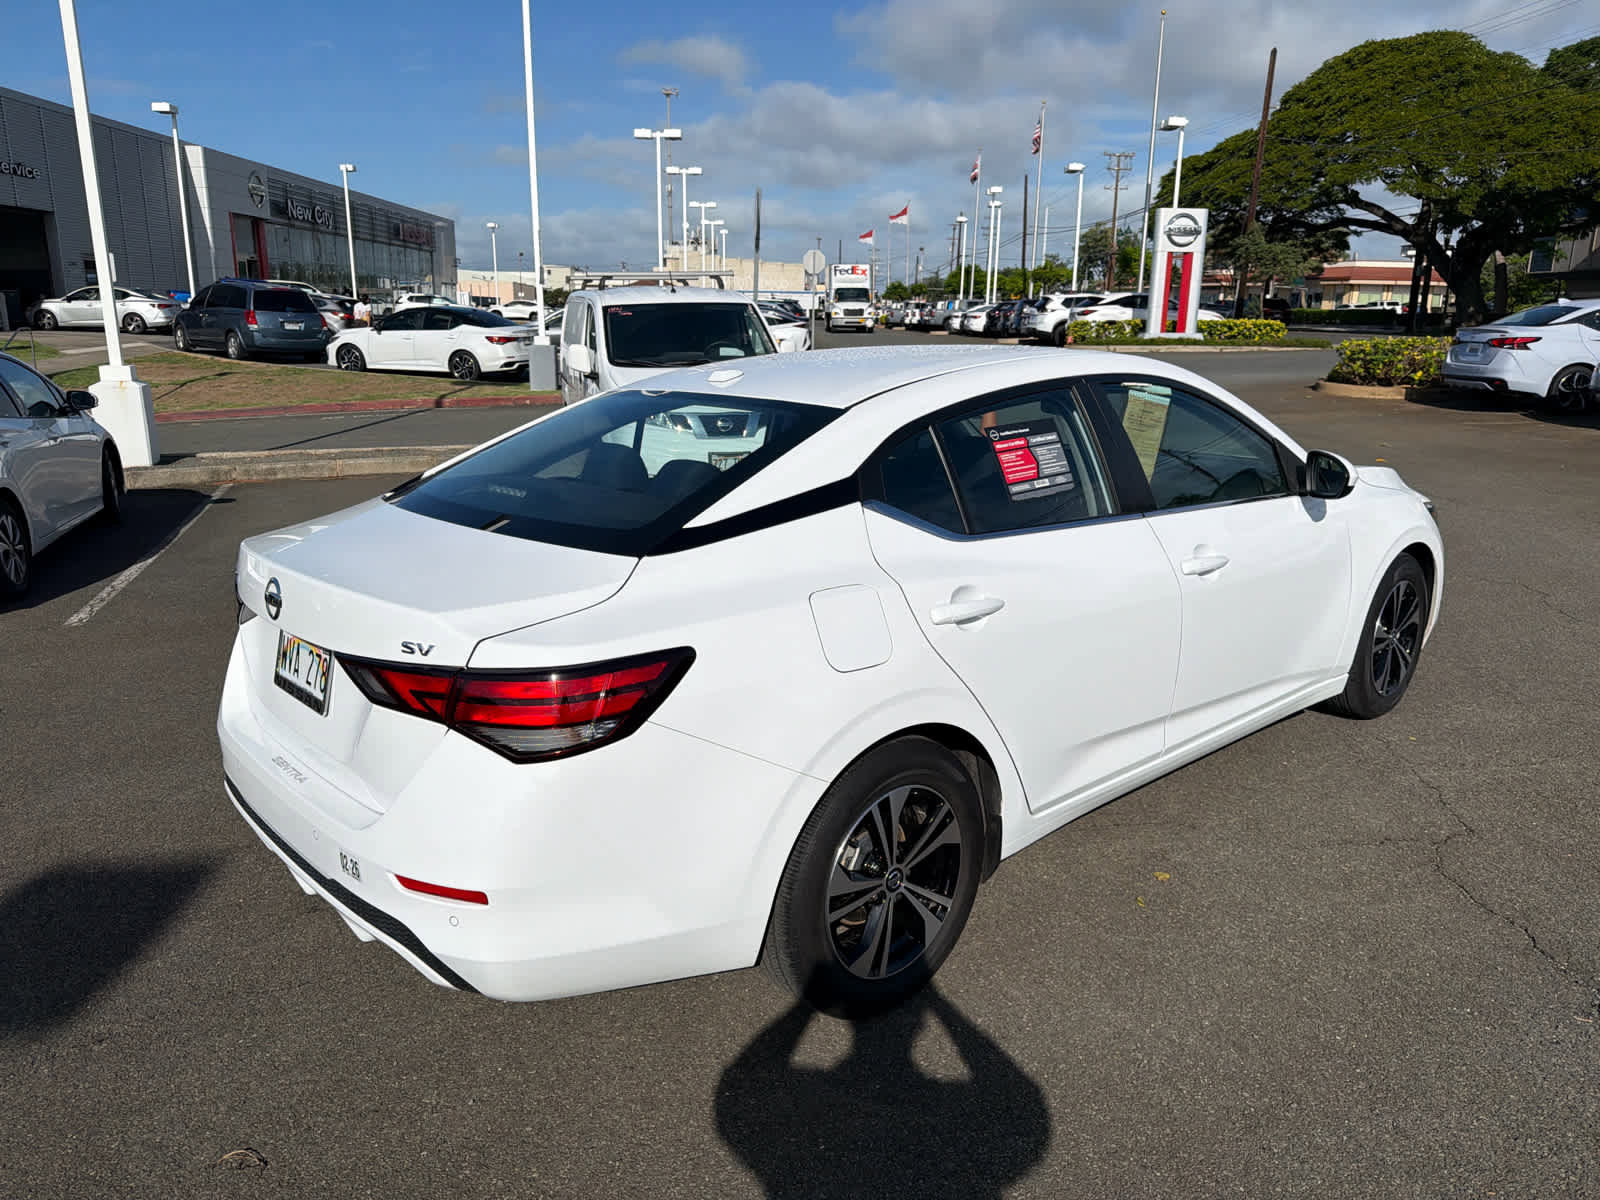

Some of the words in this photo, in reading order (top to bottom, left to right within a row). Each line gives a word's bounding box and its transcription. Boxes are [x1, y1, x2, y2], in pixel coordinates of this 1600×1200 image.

[0, 162, 40, 179] ervice
[287, 199, 312, 220] New
[314, 206, 334, 230] City
[833, 265, 868, 277] FedEx
[400, 640, 436, 657] SV
[306, 650, 328, 693] 278
[271, 756, 307, 783] SENTRA
